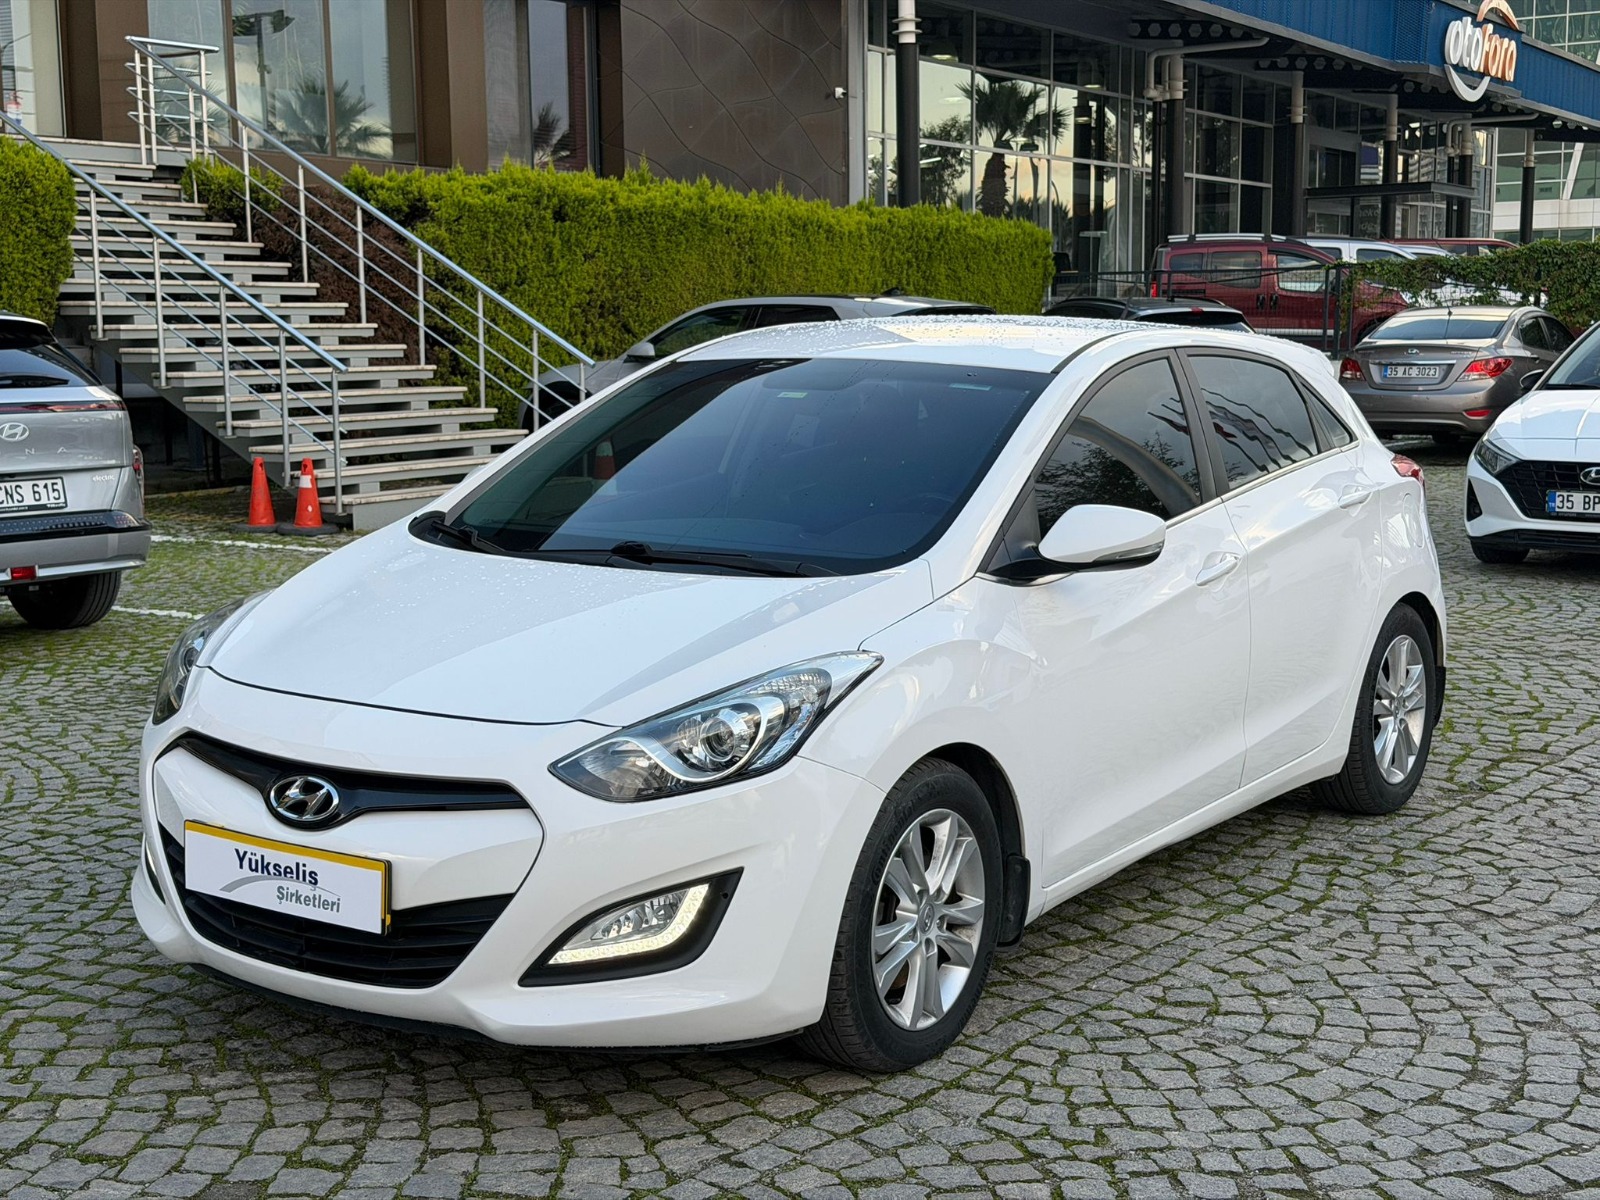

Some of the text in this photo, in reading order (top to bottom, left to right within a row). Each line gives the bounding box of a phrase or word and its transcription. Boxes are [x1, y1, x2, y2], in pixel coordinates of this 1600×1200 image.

[1387, 366, 1438, 376] 35 AC 3023
[92, 474, 115, 482] electric
[31, 482, 61, 502] 615
[1557, 494, 1574, 510] 35
[234, 848, 319, 891] Yükseliş
[276, 885, 340, 913] Şirketleri
